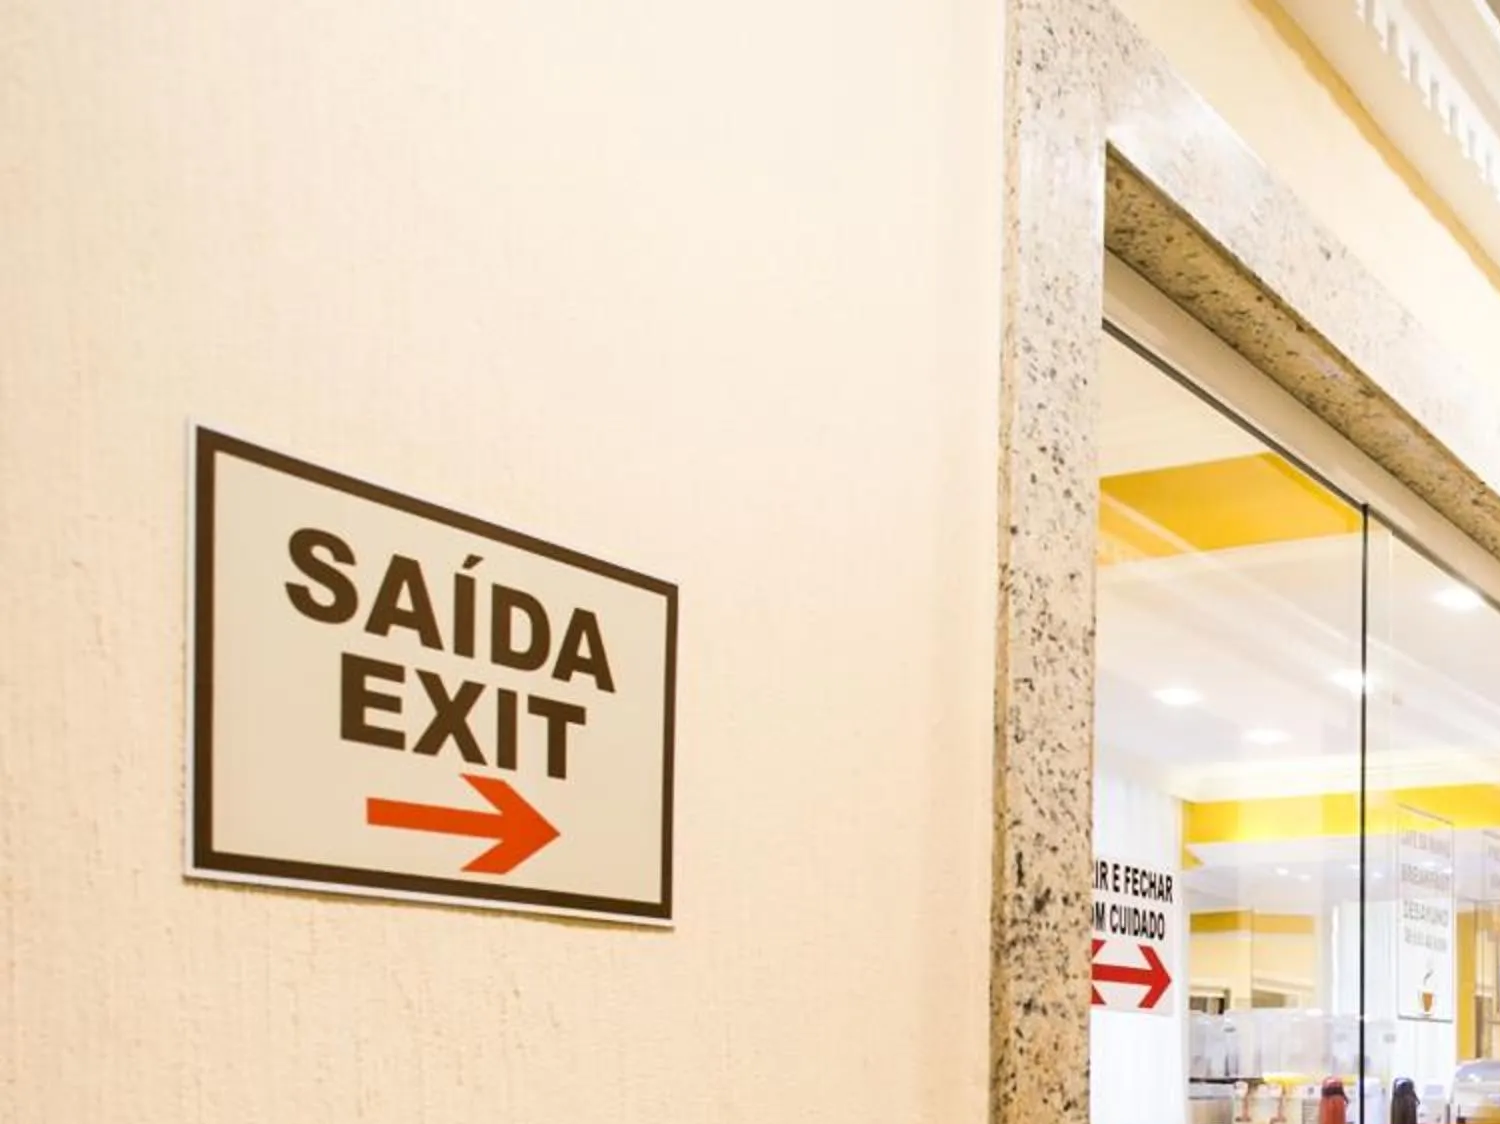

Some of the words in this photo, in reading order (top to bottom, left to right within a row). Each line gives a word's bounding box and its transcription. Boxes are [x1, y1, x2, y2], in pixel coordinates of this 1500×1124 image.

[285, 527, 615, 693] SAÍDA
[340, 651, 586, 780] EXIT
[1093, 860, 1108, 891] IR
[1112, 863, 1120, 893] E
[1124, 865, 1173, 902] FECHAR
[1110, 904, 1165, 941] CUIDADO
